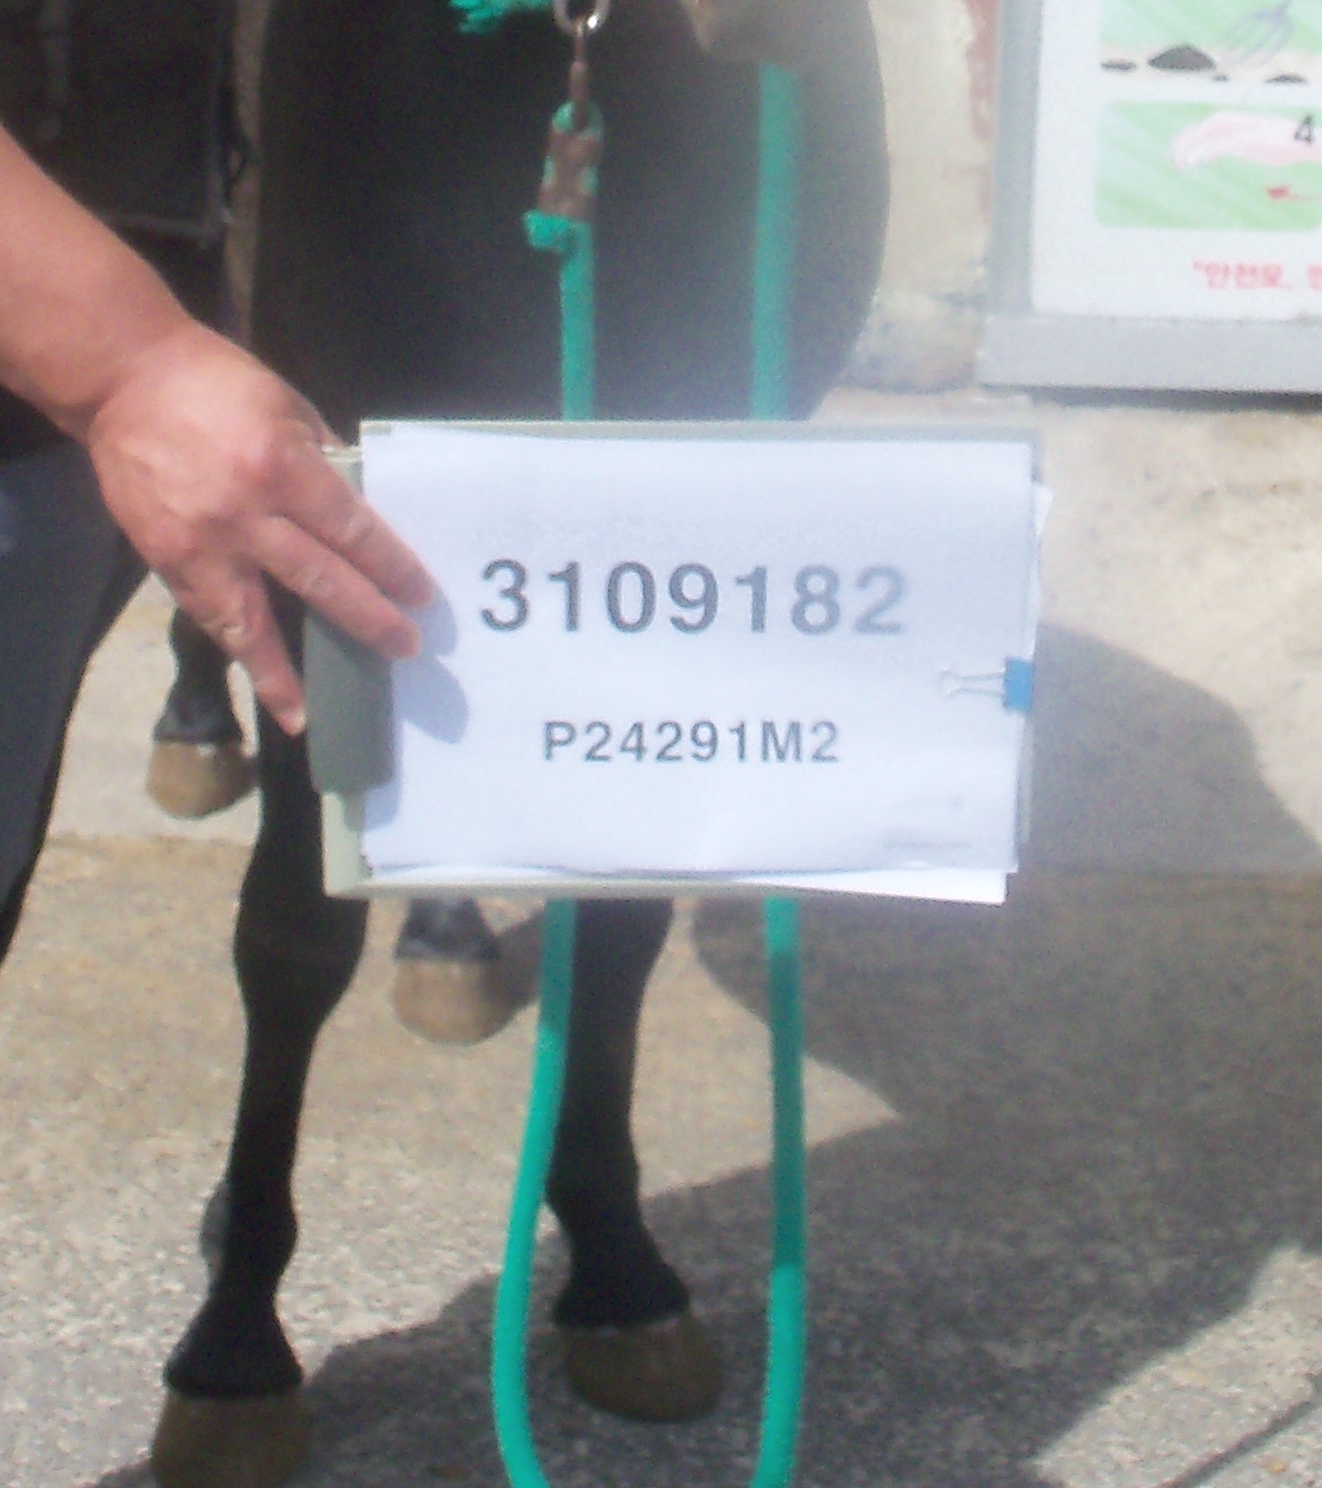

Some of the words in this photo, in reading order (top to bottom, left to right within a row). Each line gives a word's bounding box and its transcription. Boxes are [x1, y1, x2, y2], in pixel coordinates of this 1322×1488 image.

[1293, 114, 1317, 146] 4
[480, 557, 906, 635] 3109182
[543, 720, 842, 764] P24291M2
